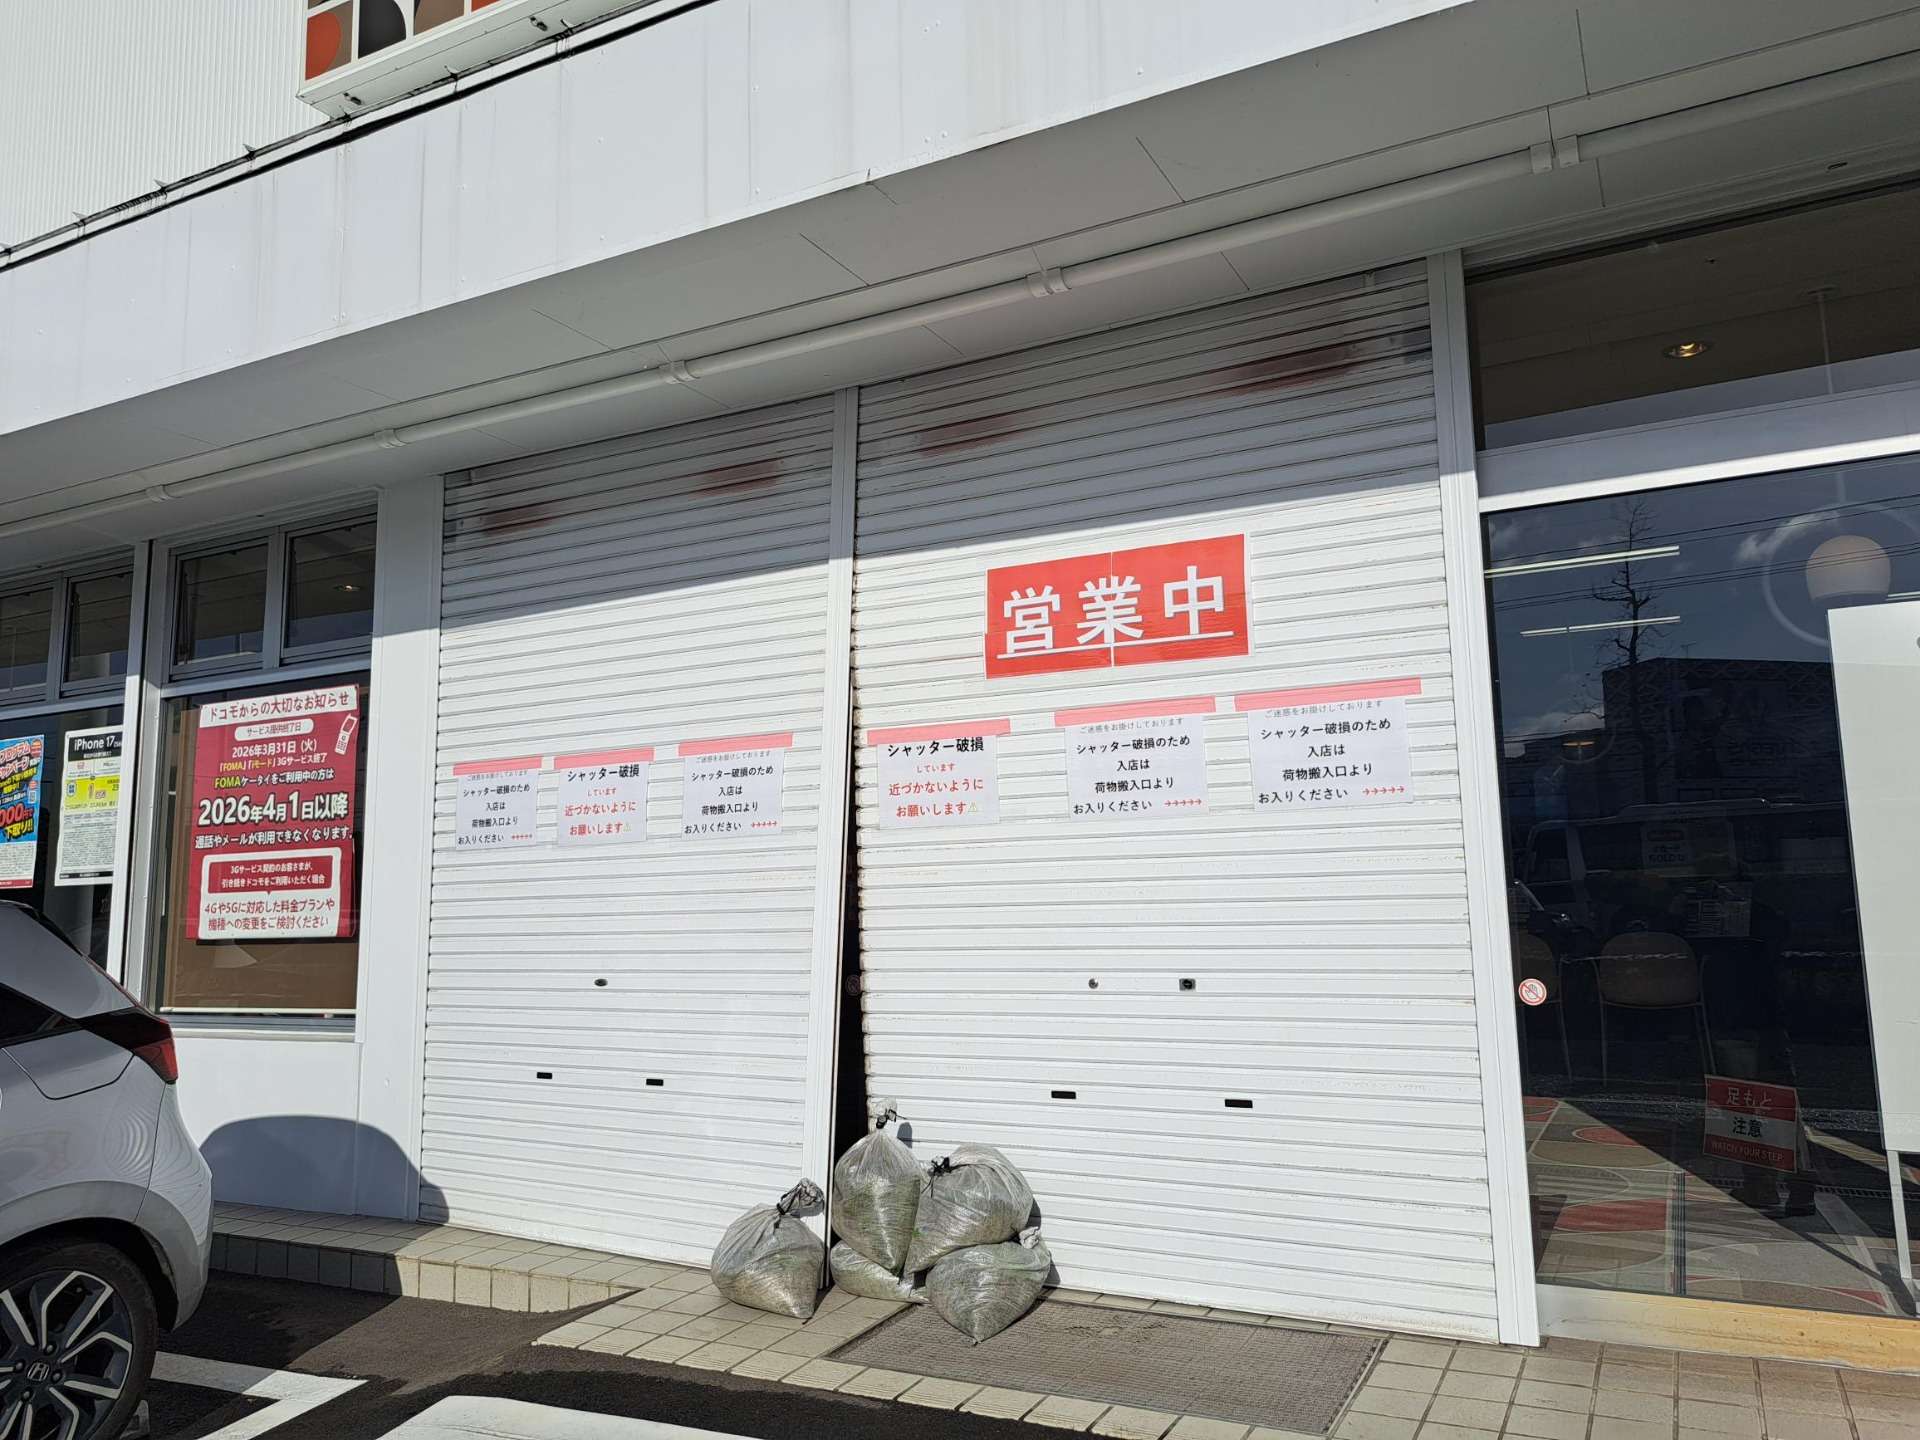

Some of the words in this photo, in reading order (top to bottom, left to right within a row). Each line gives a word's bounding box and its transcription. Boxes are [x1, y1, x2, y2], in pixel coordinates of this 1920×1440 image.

[1003, 565, 1224, 654] 営業中
[210, 691, 349, 721] ドコモからの大切なお知らせ
[1264, 700, 1383, 719] ご迷惑をお掛けしております
[1080, 718, 1183, 734] ご迷惑をお掛けしております
[1260, 718, 1391, 740] シャッター破損のため
[74, 737, 104, 751] iPhone
[106, 735, 115, 747] 17
[888, 736, 984, 757] シャッター破損
[1076, 735, 1190, 754] シャッター破損のため
[1307, 744, 1345, 758] 入店は
[567, 764, 640, 782] シャッター破損
[916, 762, 955, 773] しています
[1117, 759, 1150, 771] 入店は
[1282, 763, 1372, 782] 荷物搬入口より
[214, 768, 334, 788] FOMAケータイをご利用中の方は
[692, 766, 774, 781] シャッター破損のため
[463, 783, 530, 797] シャッター破損のため
[587, 787, 617, 797] しています
[718, 786, 743, 796] 入店は
[889, 779, 983, 796] 近づかないように
[1095, 777, 1173, 793] 荷物搬入口より
[1258, 787, 1348, 804] お入りください
[198, 791, 348, 826] 2026年4月1日以降
[486, 801, 505, 811] 入店は
[565, 801, 636, 817] 近づかないように
[702, 802, 758, 815] 荷物搬入口より
[896, 801, 967, 817] お願いします
[1073, 800, 1152, 814] お入りください
[472, 816, 518, 828] 荷物搬入口より
[569, 822, 623, 836] お願いします
[684, 822, 741, 834] お入りください
[458, 834, 504, 845] お入りください
[204, 898, 335, 915] 4Gや5Gに対応した料金プランや
[208, 916, 329, 931] 機種への変更をご検討ください
[1727, 1087, 1772, 1107] 足もと
[1733, 1116, 1762, 1137] 注意
[1712, 1141, 1737, 1153] WATCH
[1738, 1145, 1760, 1158] YOUR
[1761, 1150, 1784, 1160] STEP
